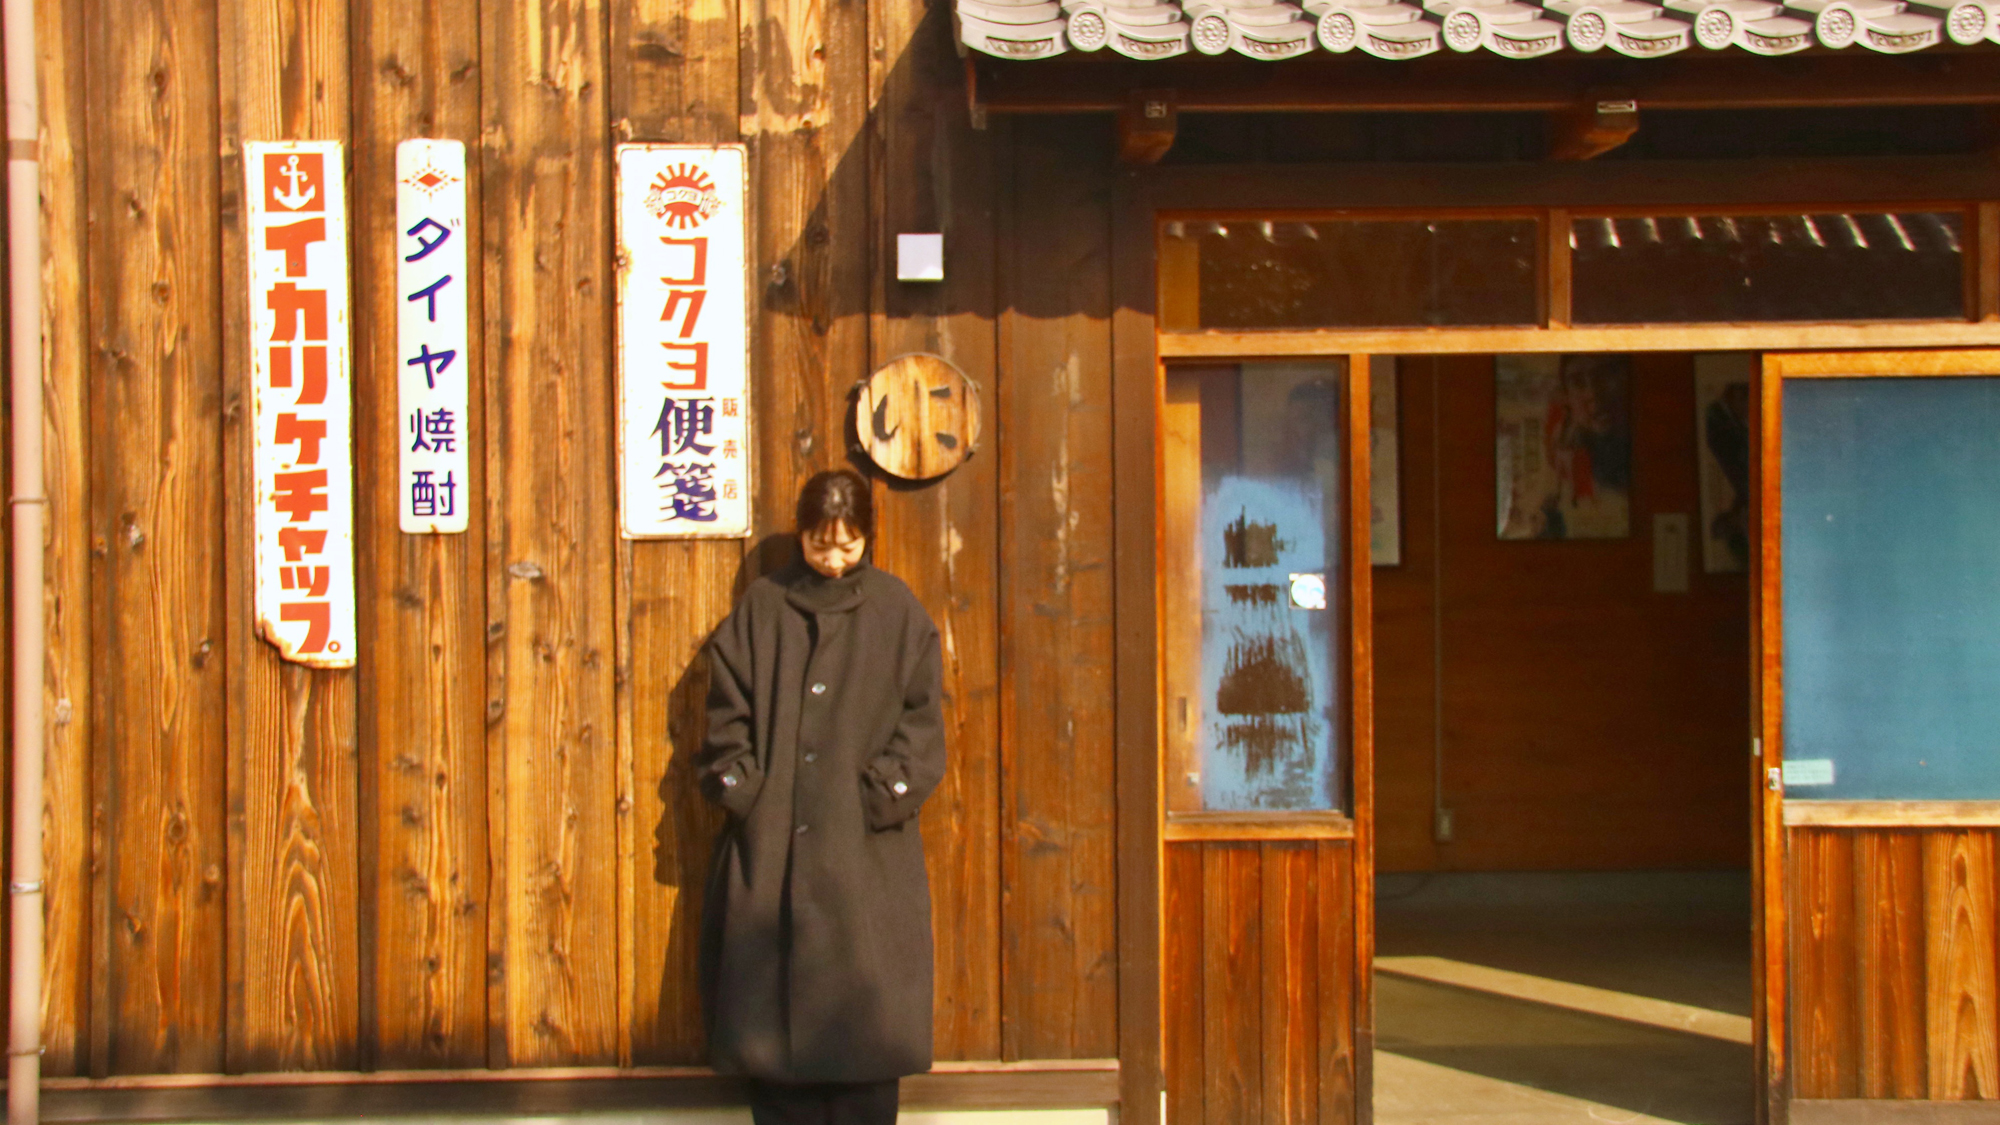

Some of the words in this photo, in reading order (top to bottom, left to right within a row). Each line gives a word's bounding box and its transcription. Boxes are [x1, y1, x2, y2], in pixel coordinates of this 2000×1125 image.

[666, 189, 699, 202] コクヨ
[722, 397, 738, 500] 販売店
